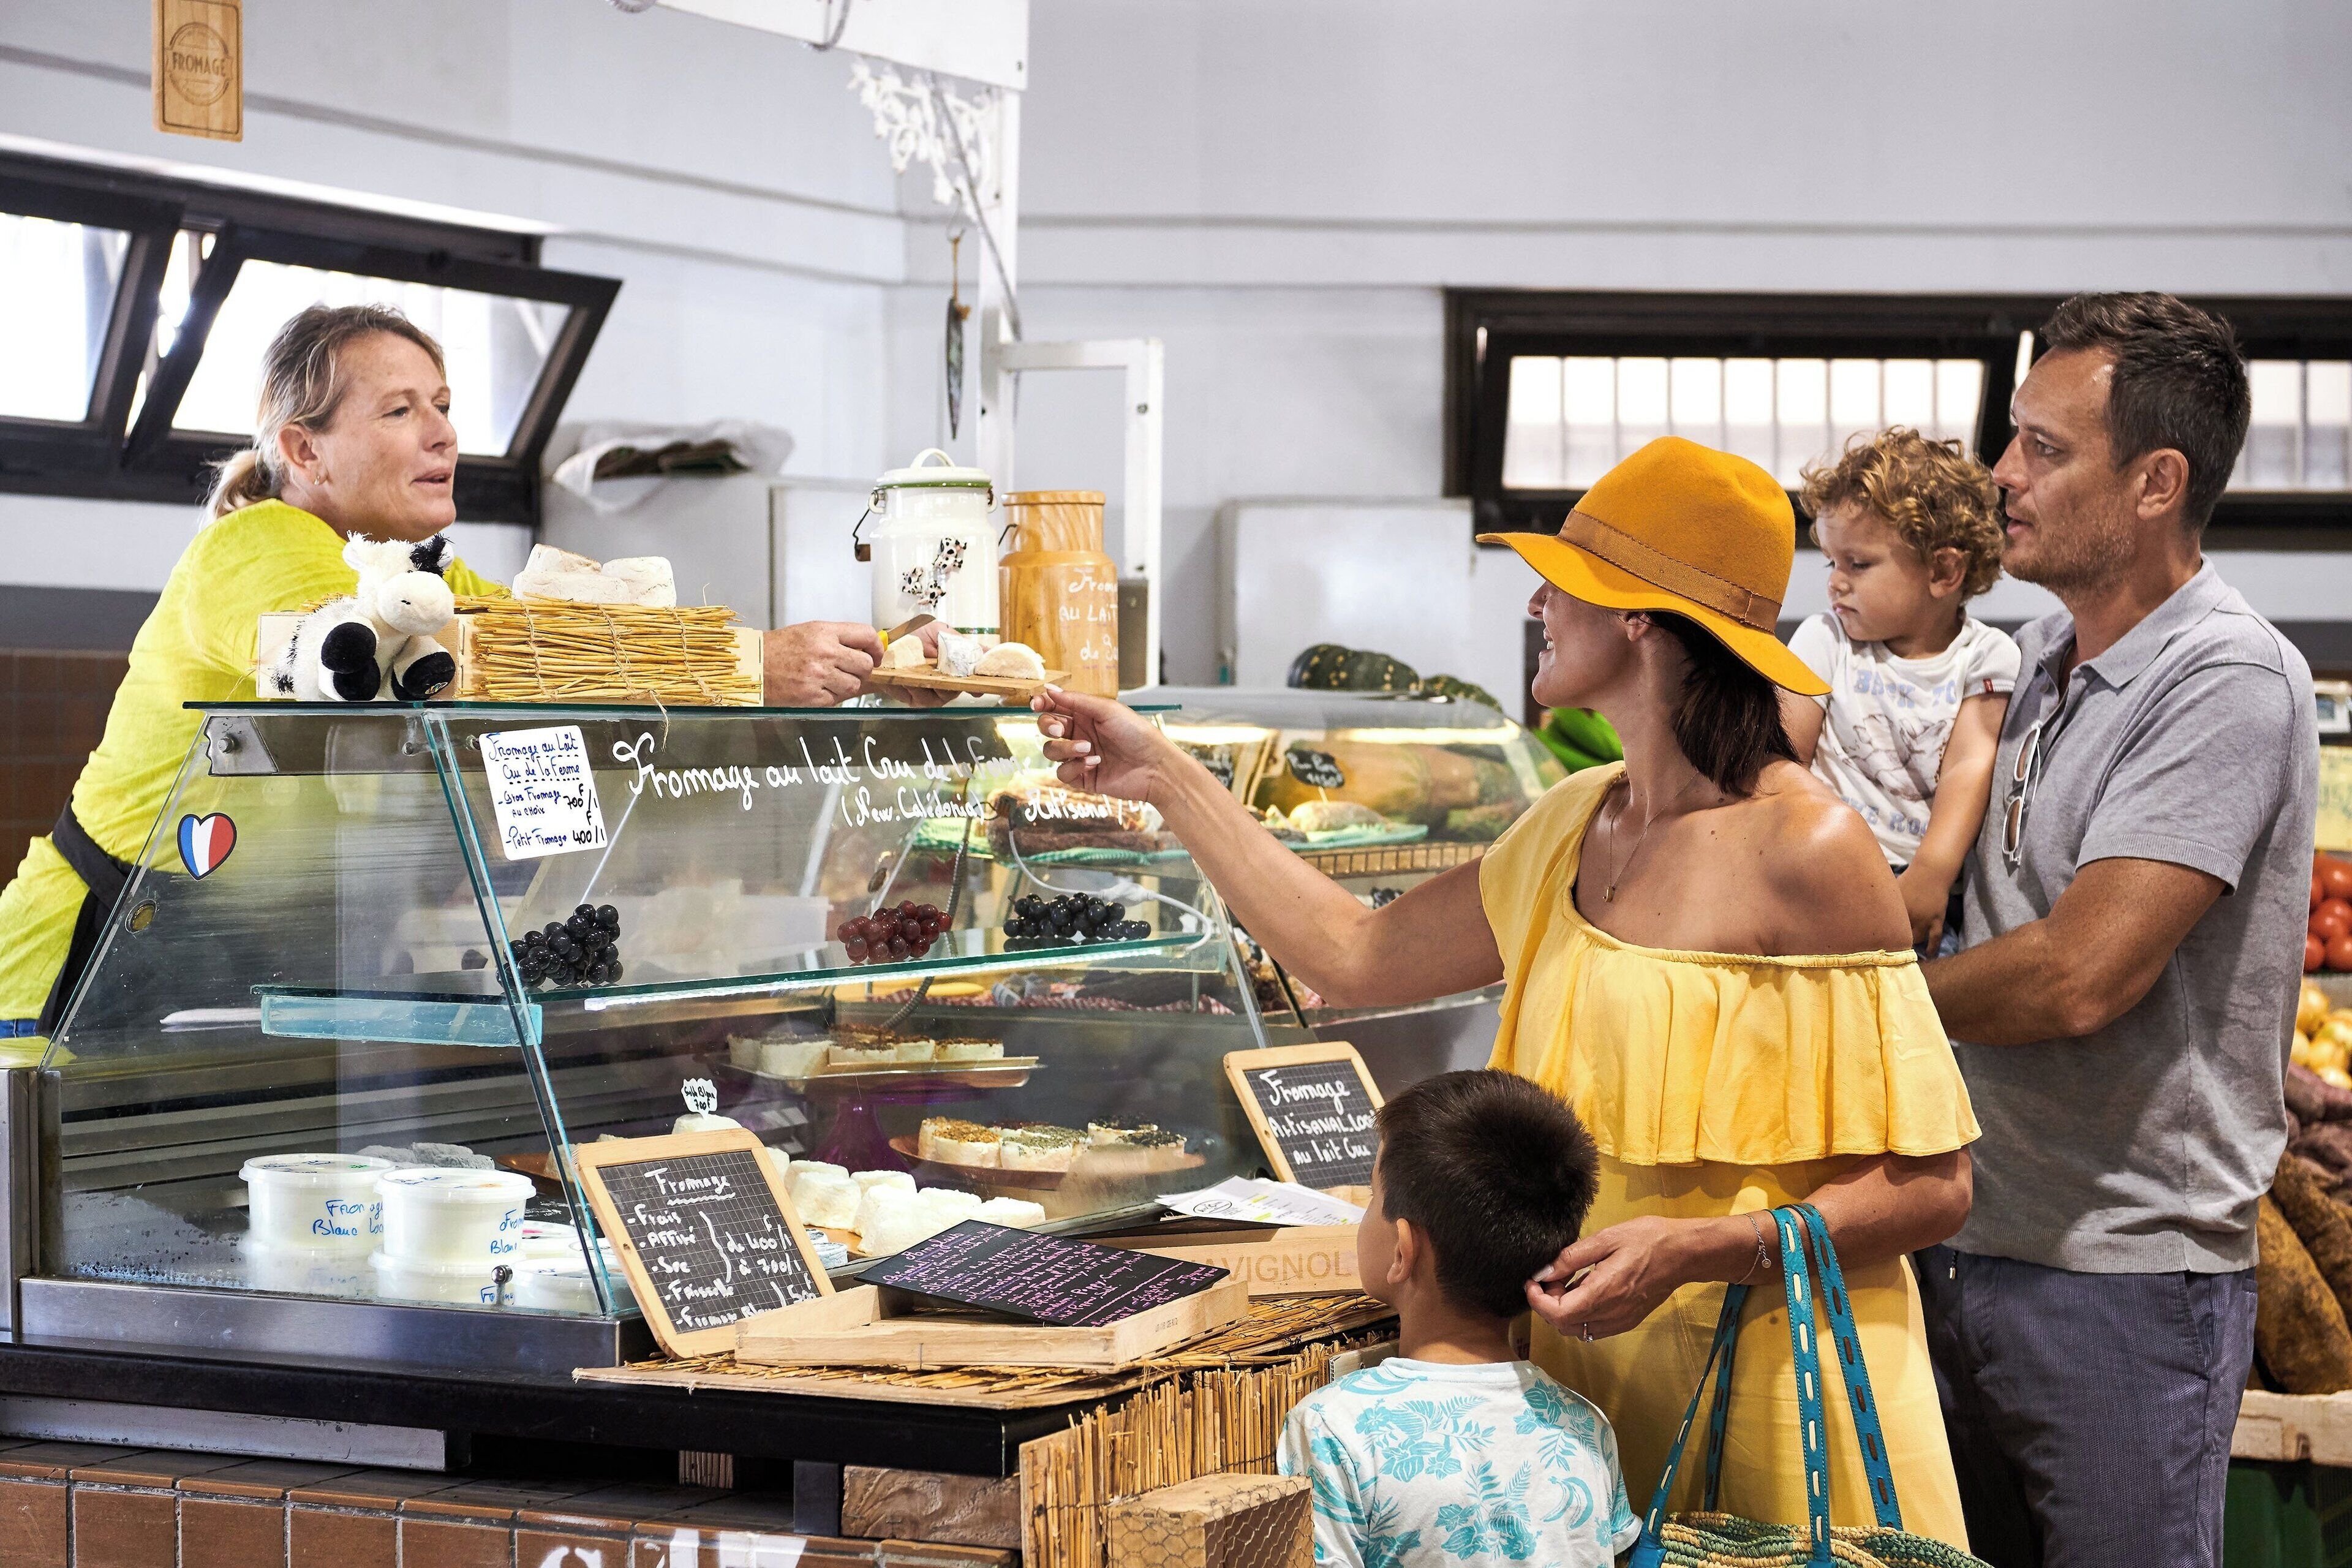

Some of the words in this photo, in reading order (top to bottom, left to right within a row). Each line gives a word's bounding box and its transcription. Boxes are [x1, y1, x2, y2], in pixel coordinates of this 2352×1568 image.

[172, 51, 226, 77] FROMAGE
[486, 732, 539, 762] Fromage
[541, 742, 556, 752] au
[525, 761, 537, 776] de
[537, 759, 551, 777] la
[550, 756, 580, 777] Ferme
[612, 732, 760, 810] Fromage
[766, 764, 802, 788] au
[799, 736, 861, 785] lait
[921, 737, 951, 781] de
[524, 786, 562, 805] Fromage
[1259, 1069, 1351, 1115] Fromage
[643, 1167, 731, 1195] Fromage
